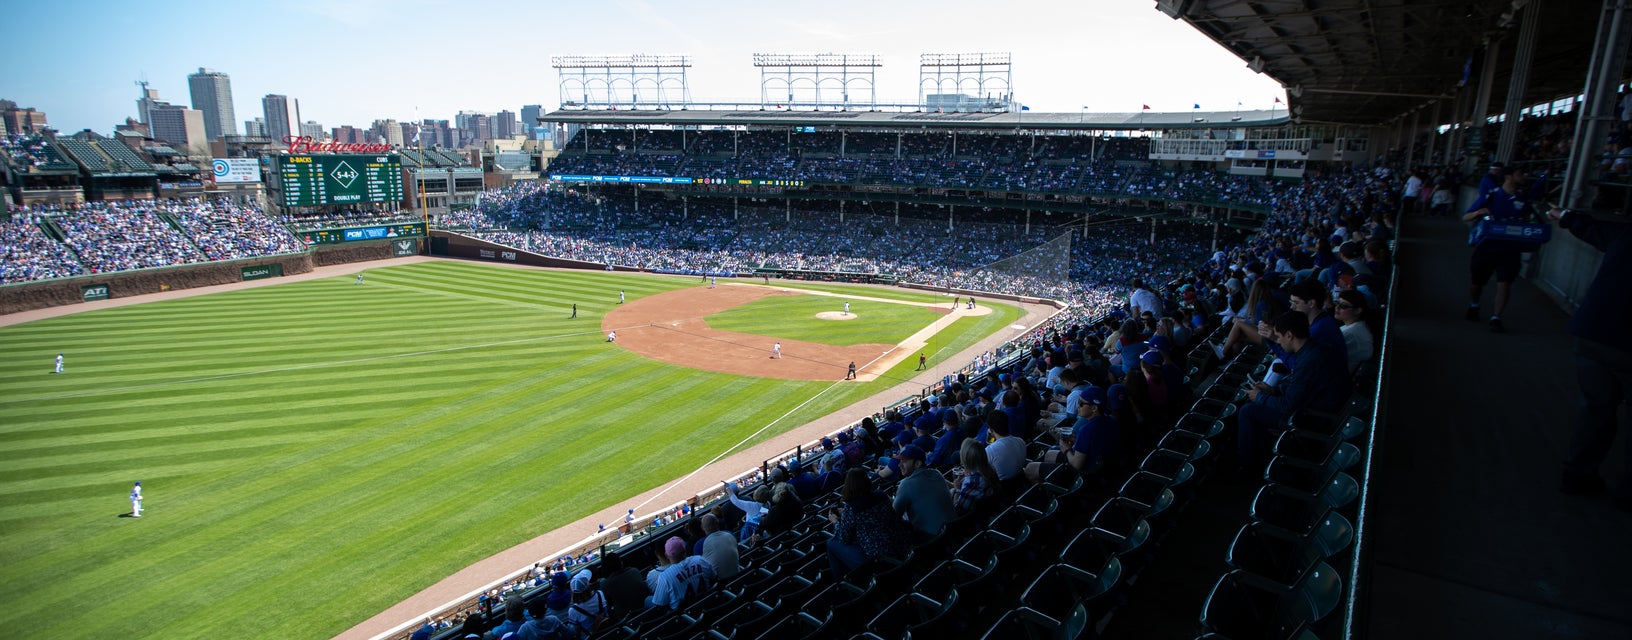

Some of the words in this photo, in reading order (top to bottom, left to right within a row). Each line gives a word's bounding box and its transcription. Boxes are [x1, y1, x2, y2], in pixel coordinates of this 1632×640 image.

[281, 135, 392, 154] Budweiser
[337, 171, 355, 179] 5-4-3
[243, 269, 269, 277] SLOAN
[84, 287, 107, 296] ATI
